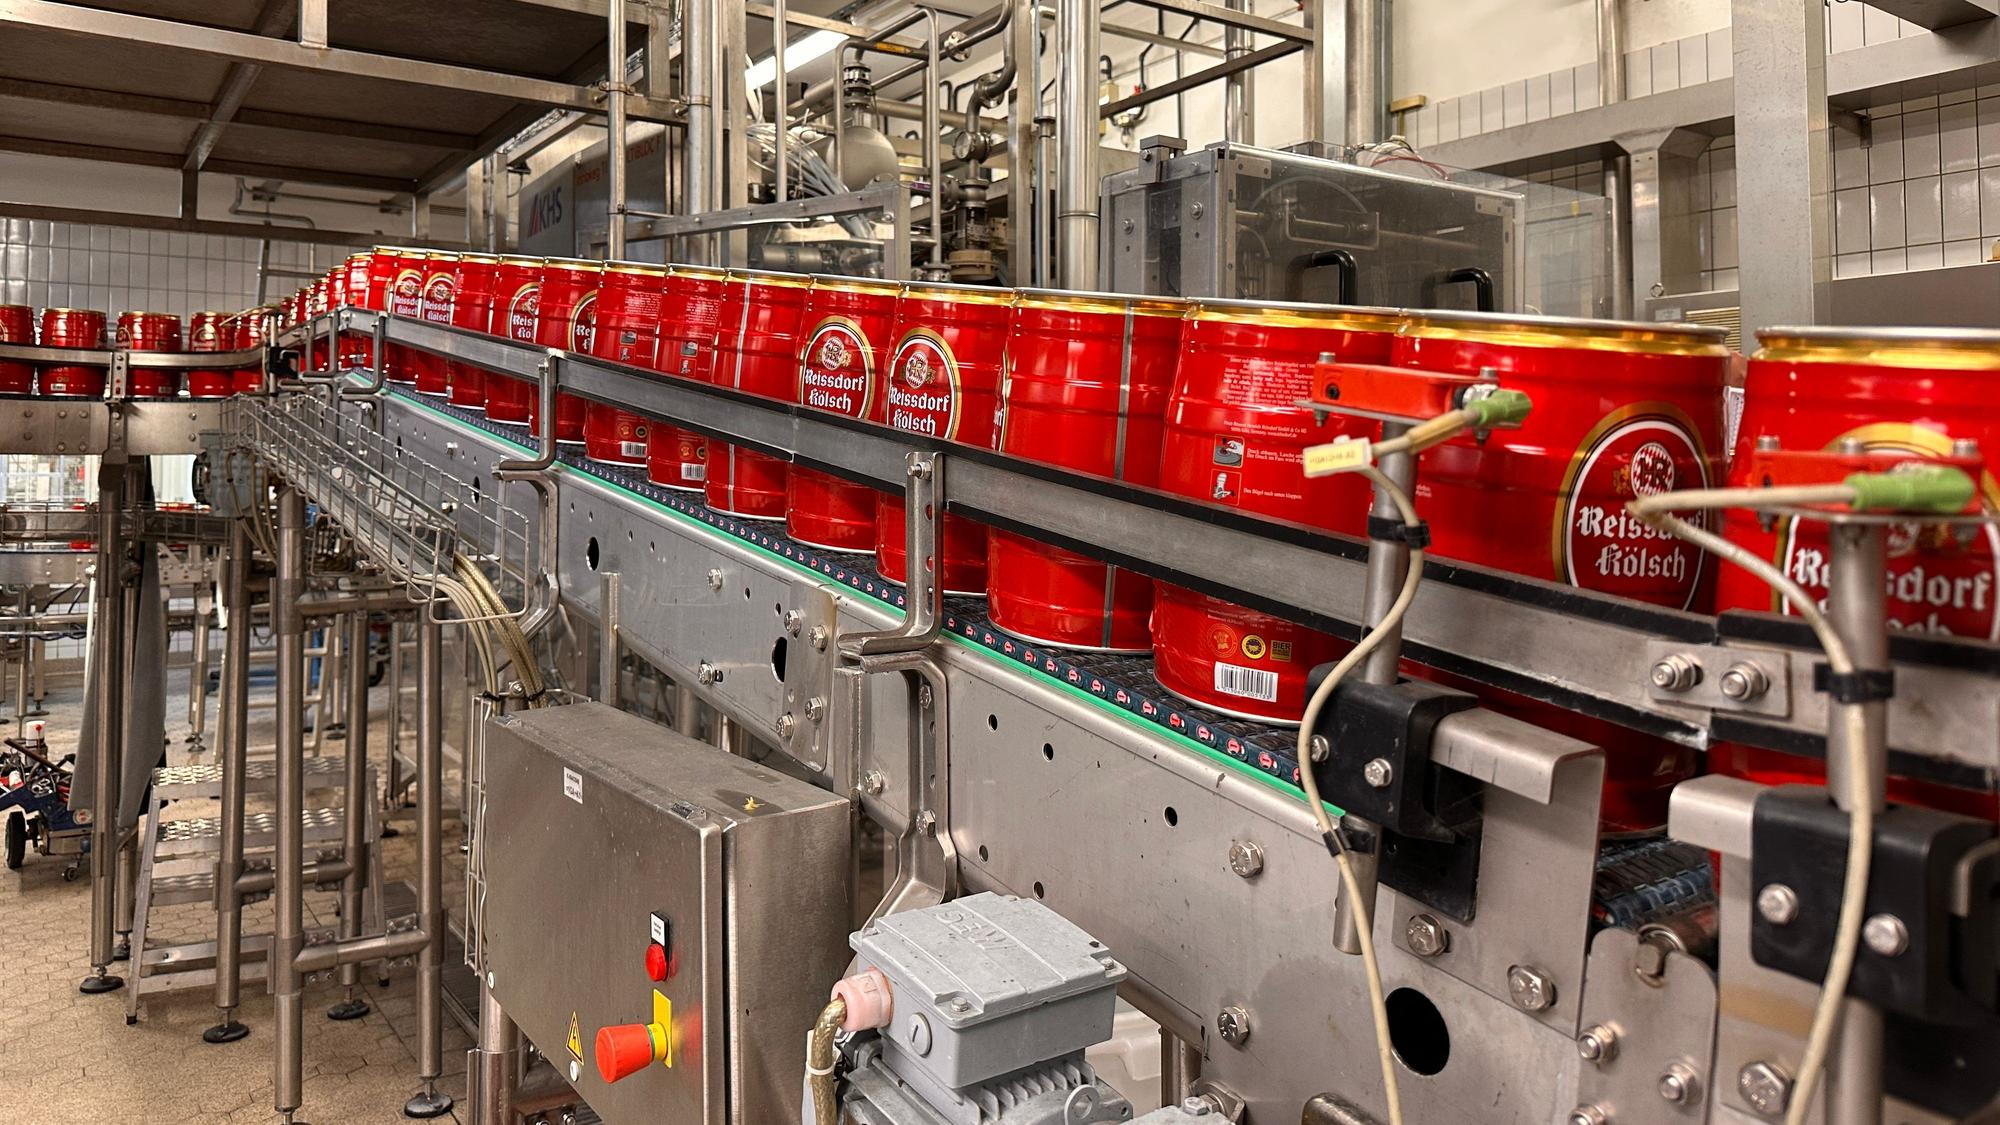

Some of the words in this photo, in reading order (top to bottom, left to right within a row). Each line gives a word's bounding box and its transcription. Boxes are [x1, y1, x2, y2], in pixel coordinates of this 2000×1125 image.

[539, 186, 562, 230] KHS
[512, 314, 534, 326] Reis
[804, 368, 865, 392] Reissdorf
[808, 388, 852, 413] Kölsch
[890, 386, 950, 412] Reissdorf
[893, 408, 936, 436] Kölsch
[1596, 543, 1686, 582] Kölsch
